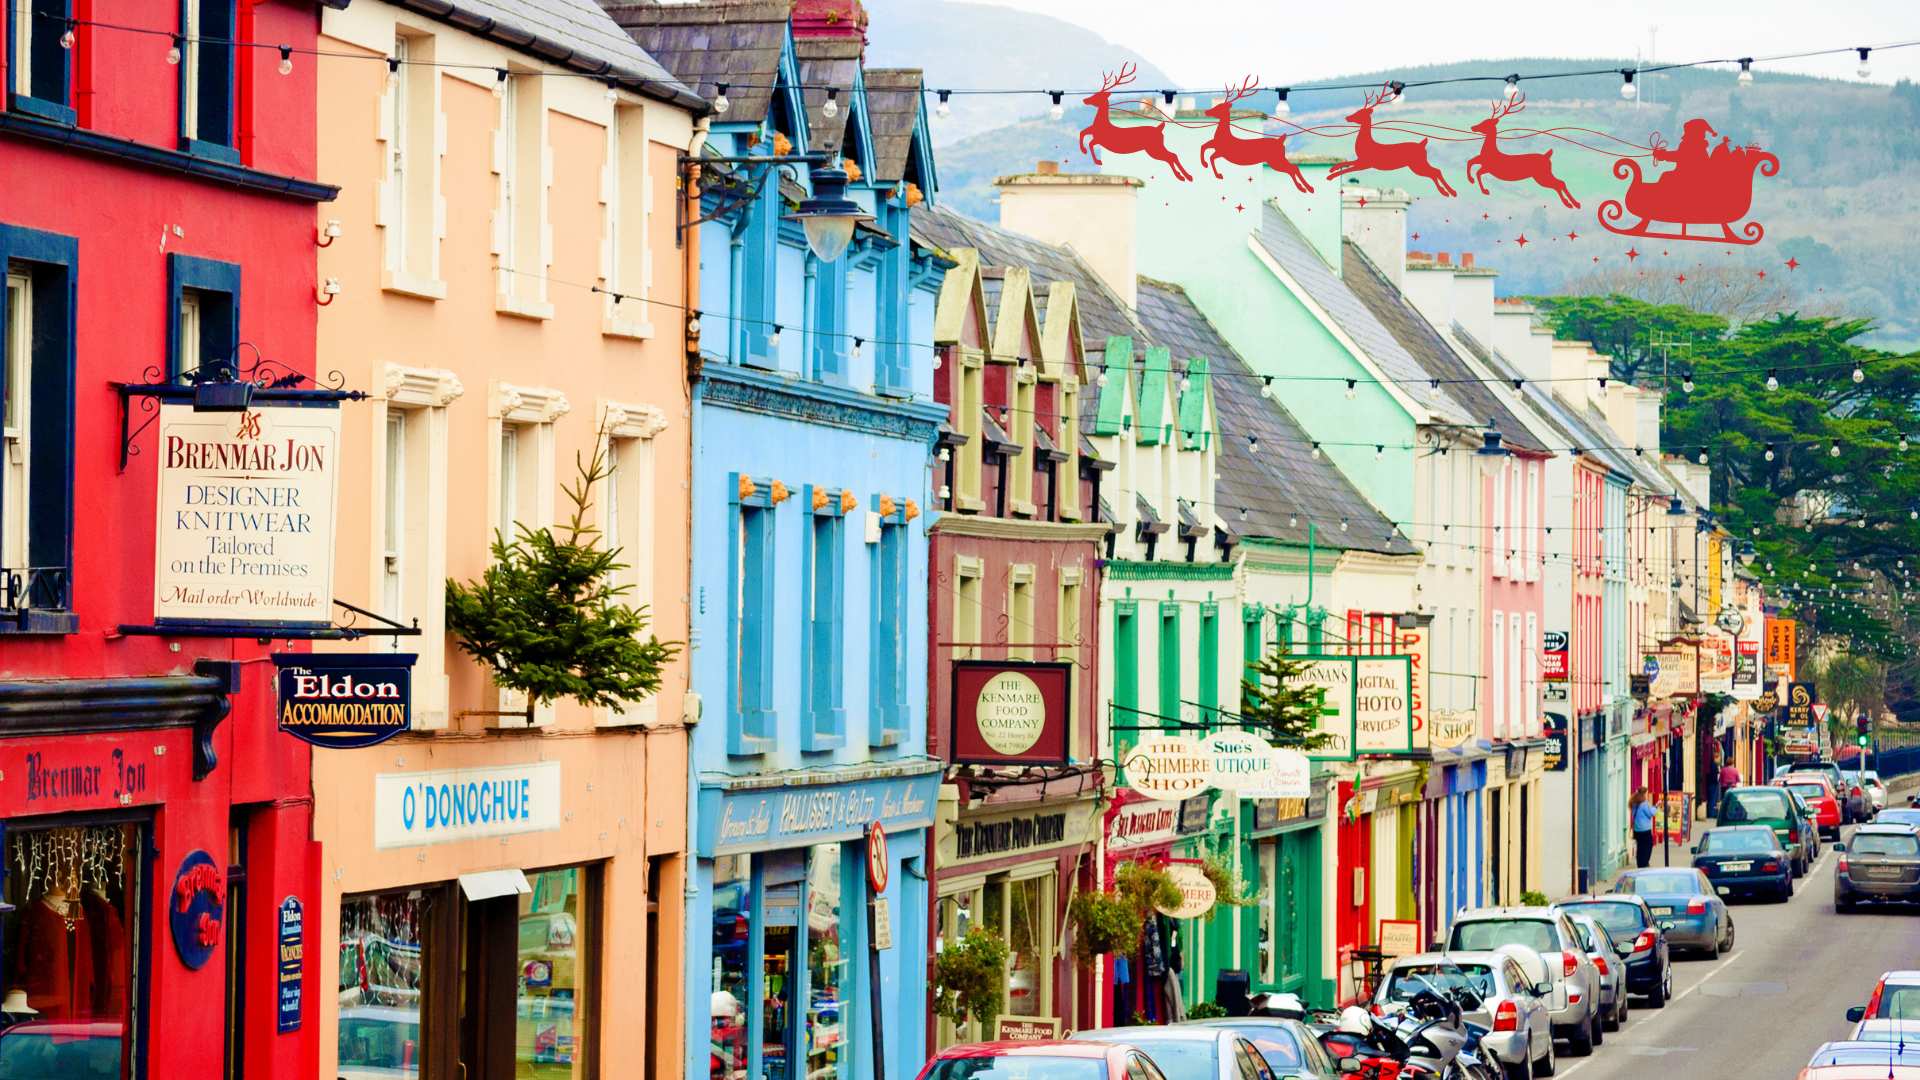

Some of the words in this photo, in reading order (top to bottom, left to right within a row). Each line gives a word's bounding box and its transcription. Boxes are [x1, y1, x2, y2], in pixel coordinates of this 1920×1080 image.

[166, 435, 276, 471] BRENMAR
[280, 439, 325, 472] JON
[186, 485, 300, 507] DESIGNER
[176, 511, 311, 533] KNITWEAR
[206, 536, 274, 555] Tailored
[171, 559, 194, 574] on
[200, 555, 226, 574] the
[231, 557, 308, 577] Premises
[161, 586, 205, 603] Mail
[207, 589, 241, 605] order
[241, 589, 317, 608] Worldwide
[291, 667, 312, 675] The
[293, 674, 400, 698] Eldon
[1001, 681, 1020, 690] THE
[981, 693, 1040, 703] KENMARE
[1357, 696, 1402, 711] HOTO
[281, 700, 405, 725] ACCOMMODATION
[996, 706, 1028, 716] FOOD
[981, 719, 1039, 728] COMPANY
[1356, 718, 1400, 733] ERVICES
[1151, 744, 1186, 753] THE
[1213, 739, 1252, 753] Sue's
[1128, 758, 1210, 774] CASHMERE
[1216, 757, 1271, 774] UTIQUE
[26, 752, 100, 800] Brenmar
[112, 748, 145, 799] Jon
[1138, 778, 1204, 791] SHOP
[403, 779, 529, 830] O'DONOGHUE
[1182, 888, 1211, 900] MERE
